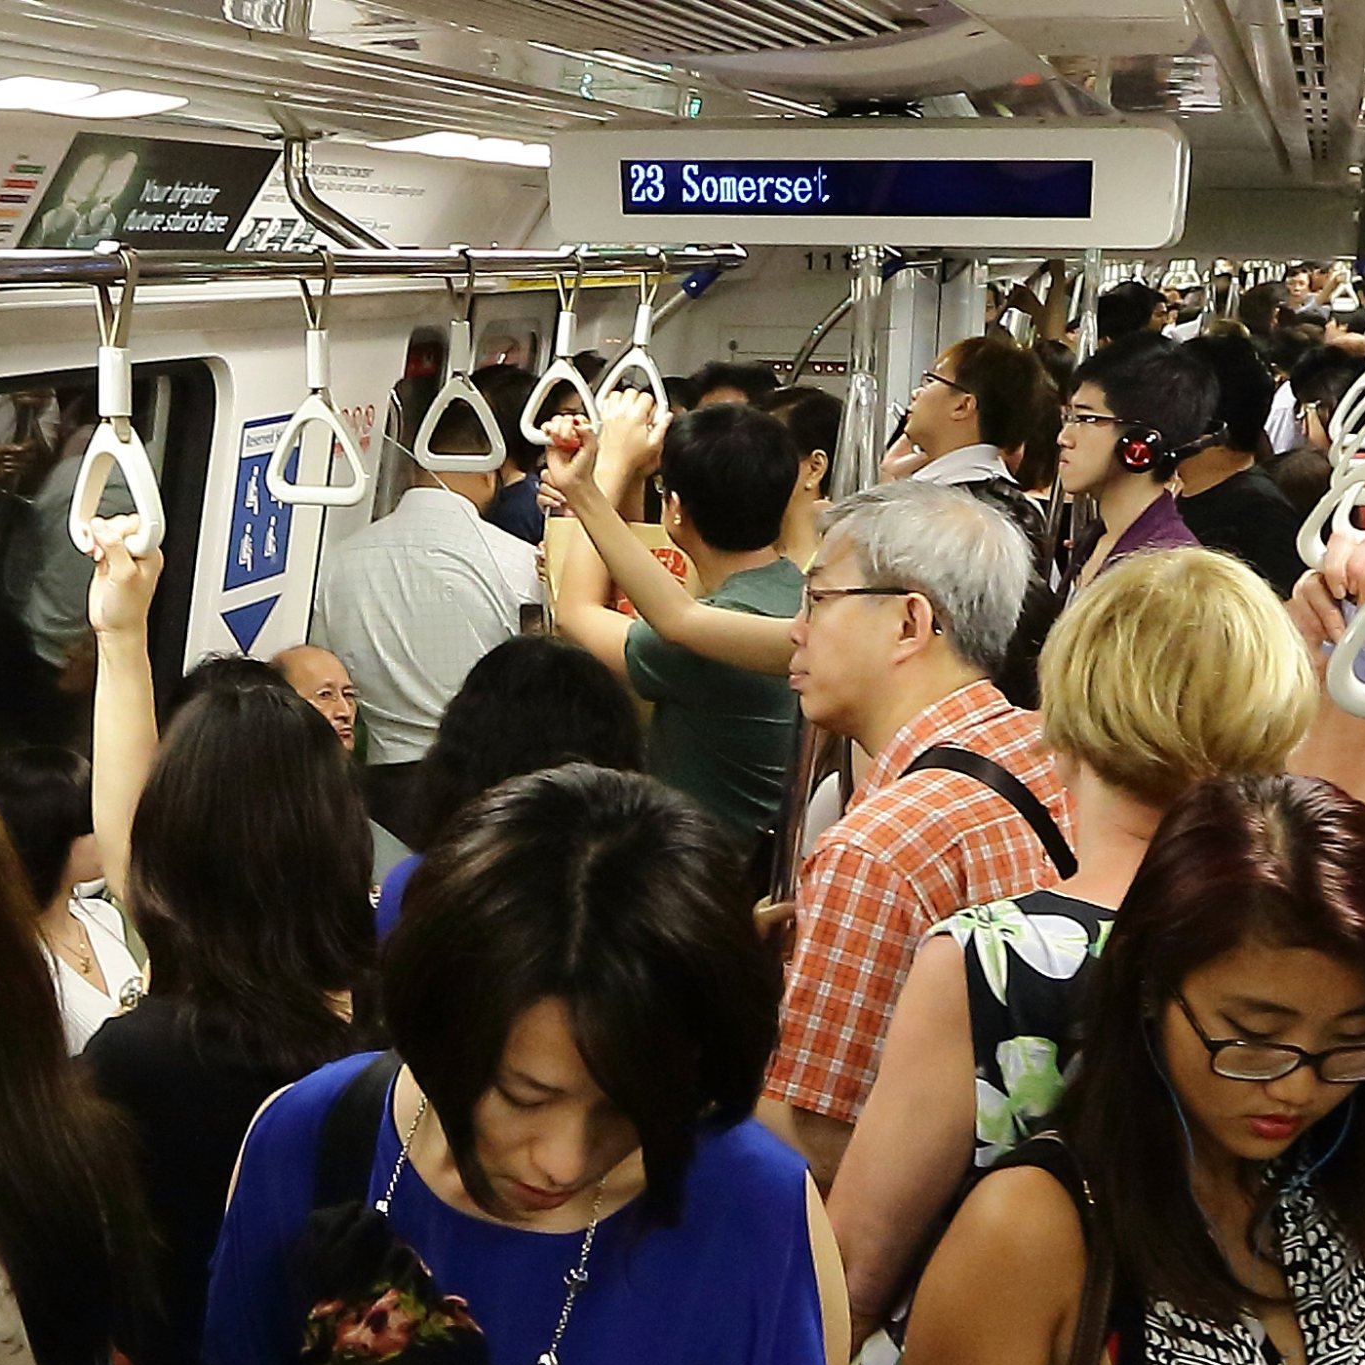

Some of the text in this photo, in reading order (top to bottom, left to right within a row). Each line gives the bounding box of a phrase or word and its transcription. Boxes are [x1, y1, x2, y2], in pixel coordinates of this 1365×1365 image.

[167, 181, 220, 210] brighter
[630, 164, 830, 203] 23 Somerset
[122, 209, 229, 233] future starts here
